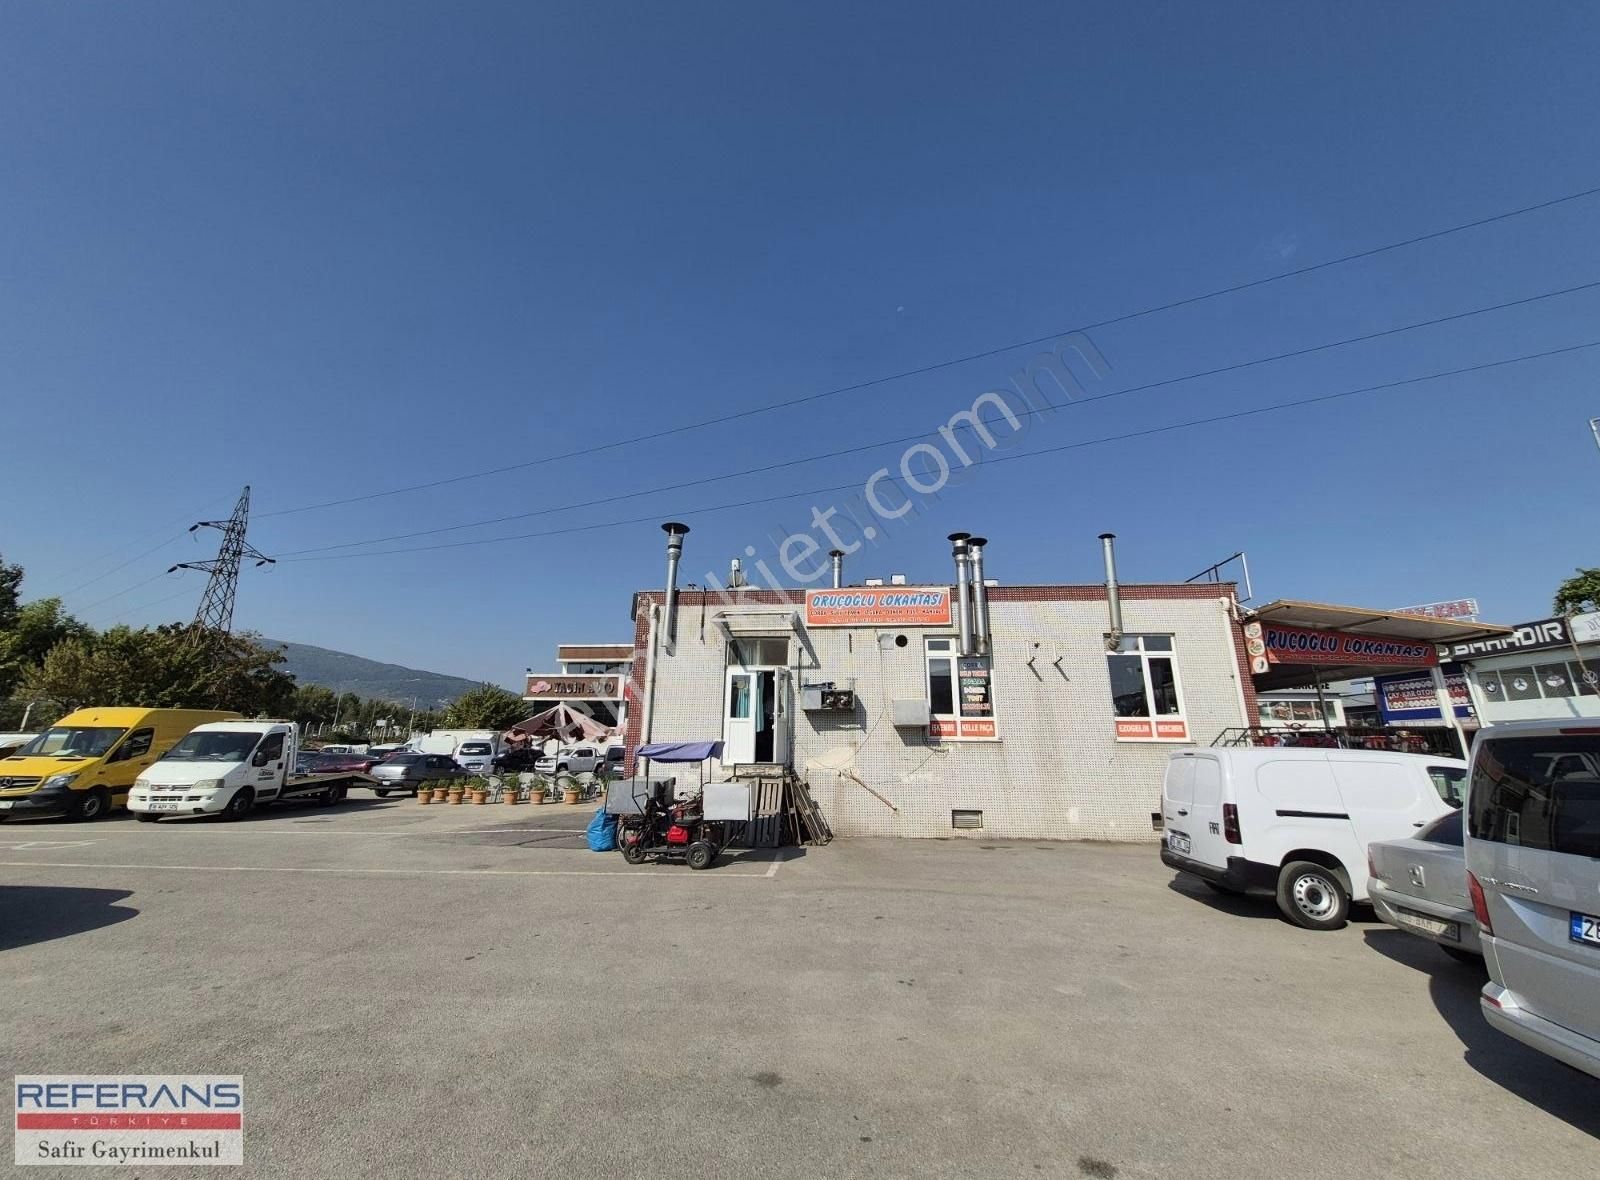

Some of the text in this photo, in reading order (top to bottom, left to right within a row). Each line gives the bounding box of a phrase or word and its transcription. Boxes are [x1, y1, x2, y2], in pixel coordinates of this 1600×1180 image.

[812, 591, 943, 609] ORUÇOĞLU LOKANTASI
[1343, 638, 1431, 658] LOKANTASI
